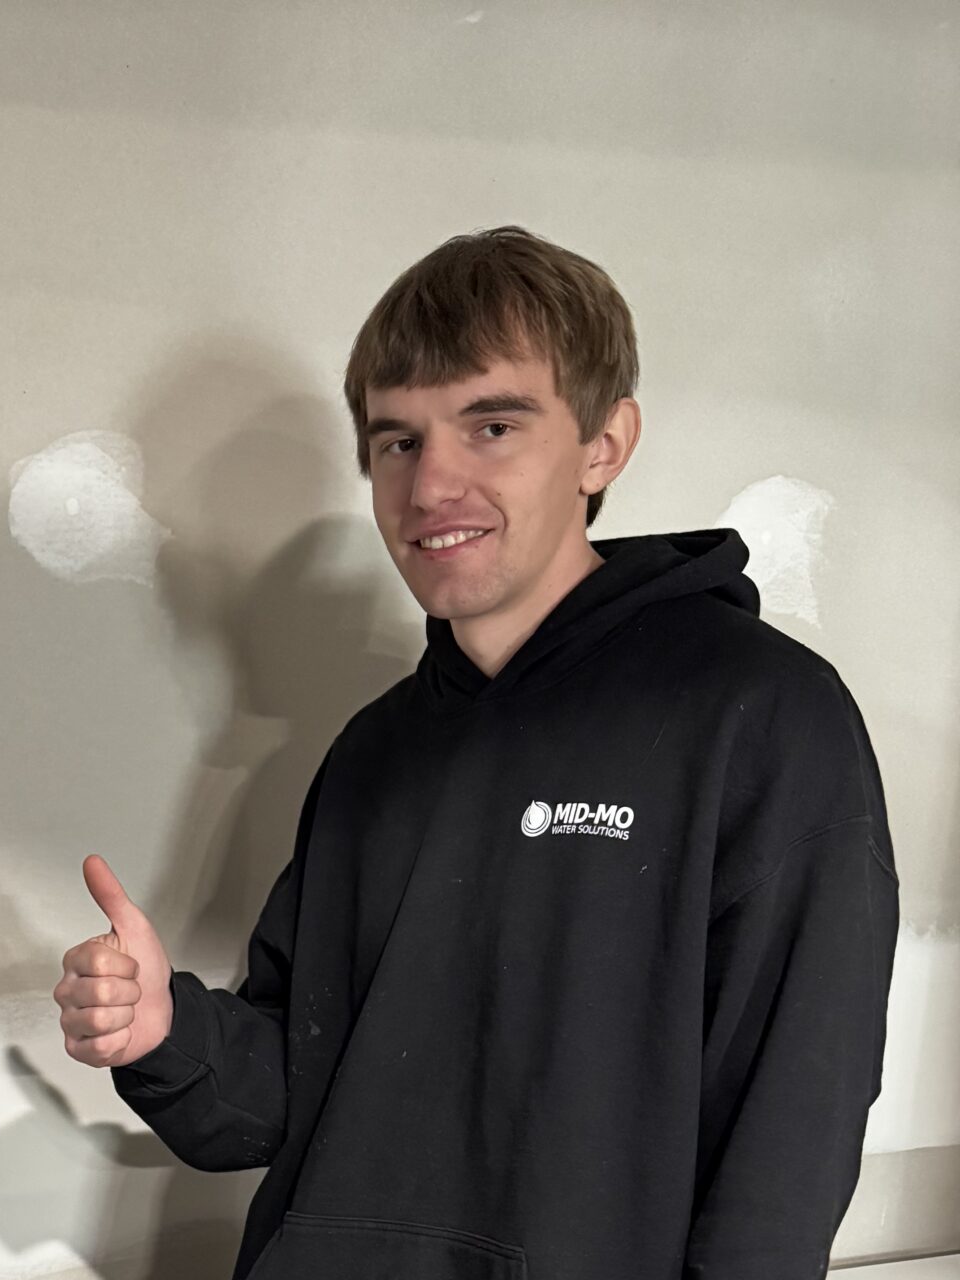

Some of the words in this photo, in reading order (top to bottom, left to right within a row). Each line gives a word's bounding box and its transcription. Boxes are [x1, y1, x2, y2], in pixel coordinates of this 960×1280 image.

[553, 803, 635, 829] MID-MO
[551, 824, 576, 835] WATER
[577, 824, 630, 840] SOLUTIONS
